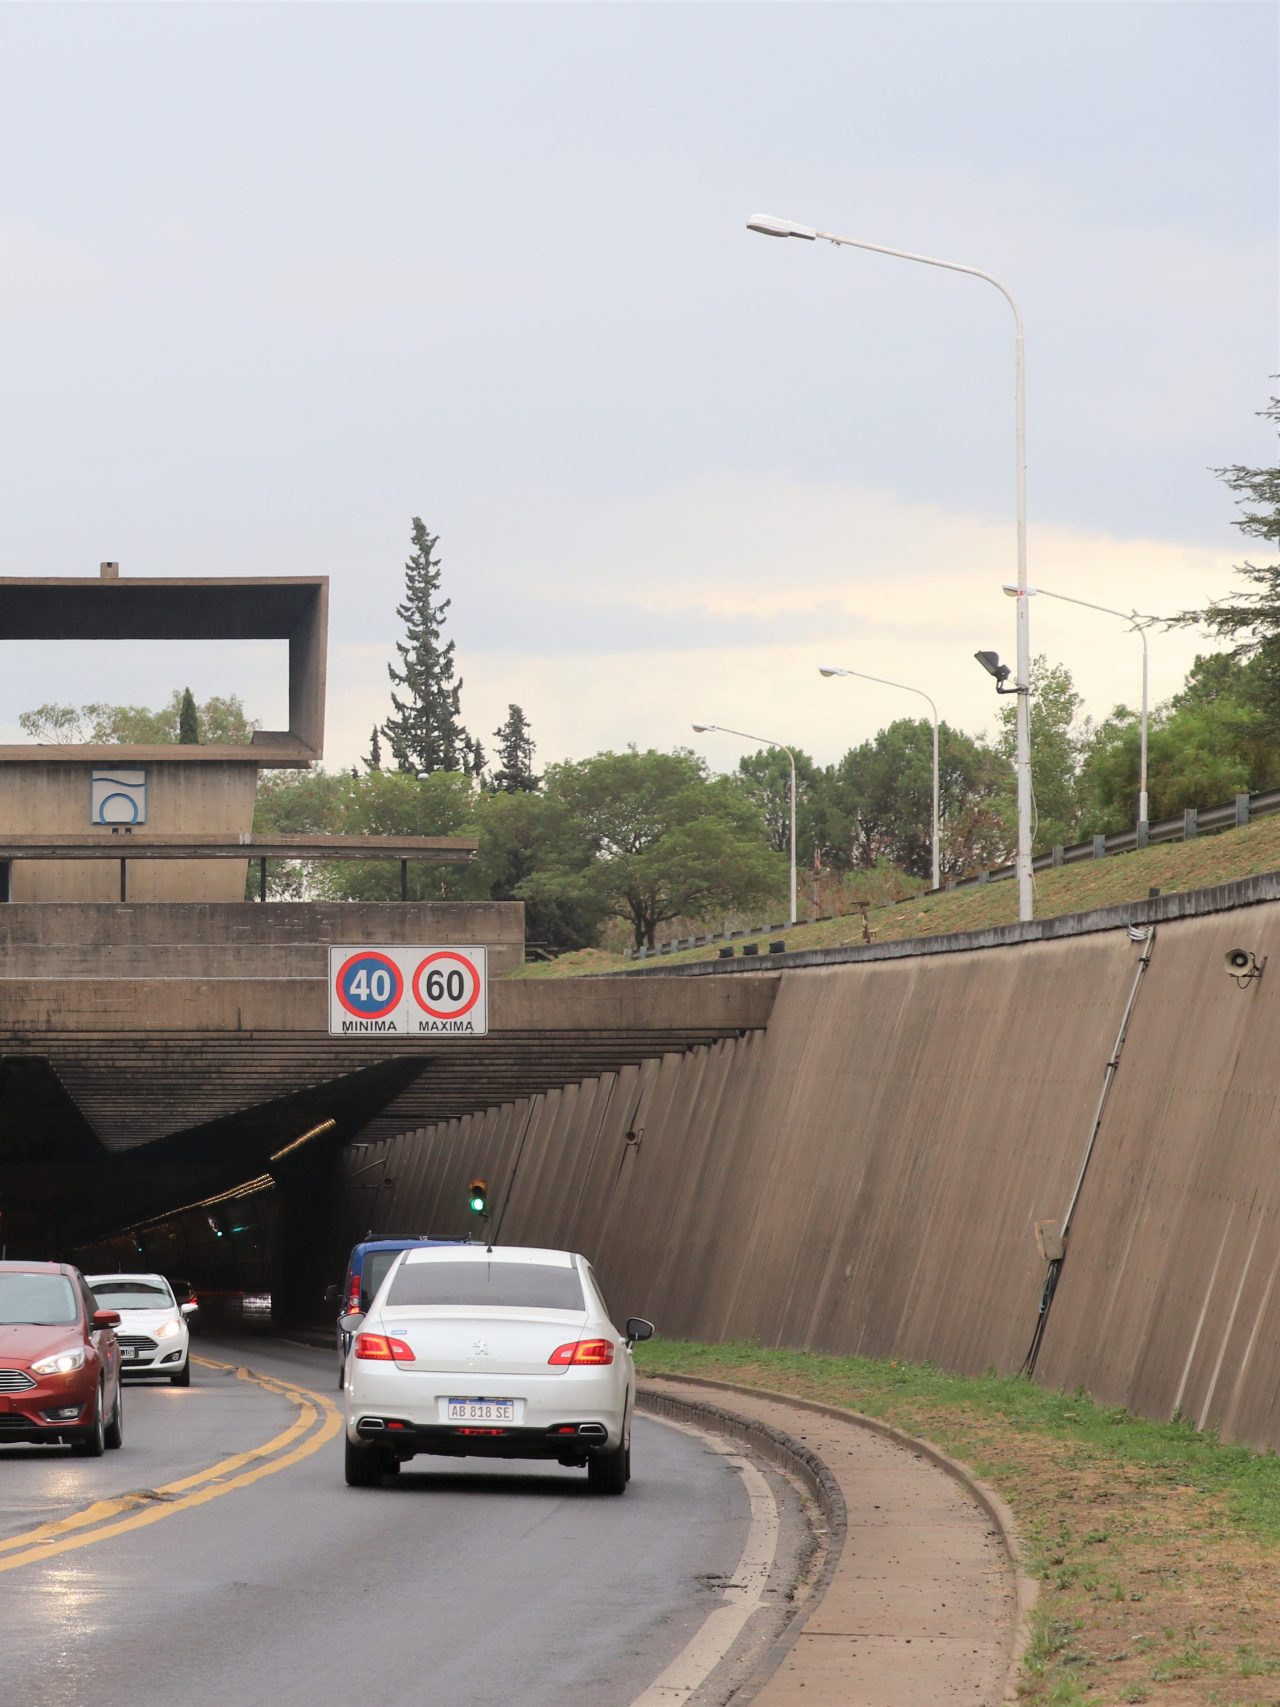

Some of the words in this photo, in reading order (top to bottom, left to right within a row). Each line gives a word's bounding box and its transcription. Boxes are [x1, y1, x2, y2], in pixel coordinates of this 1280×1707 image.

[349, 969, 391, 1002] 40
[426, 969, 464, 1002] 60
[342, 1020, 398, 1032] MINIMA
[418, 1020, 474, 1032] MAXIMA
[451, 1406, 466, 1417] AB
[470, 1406, 492, 1418] 818
[496, 1407, 510, 1419] SE
